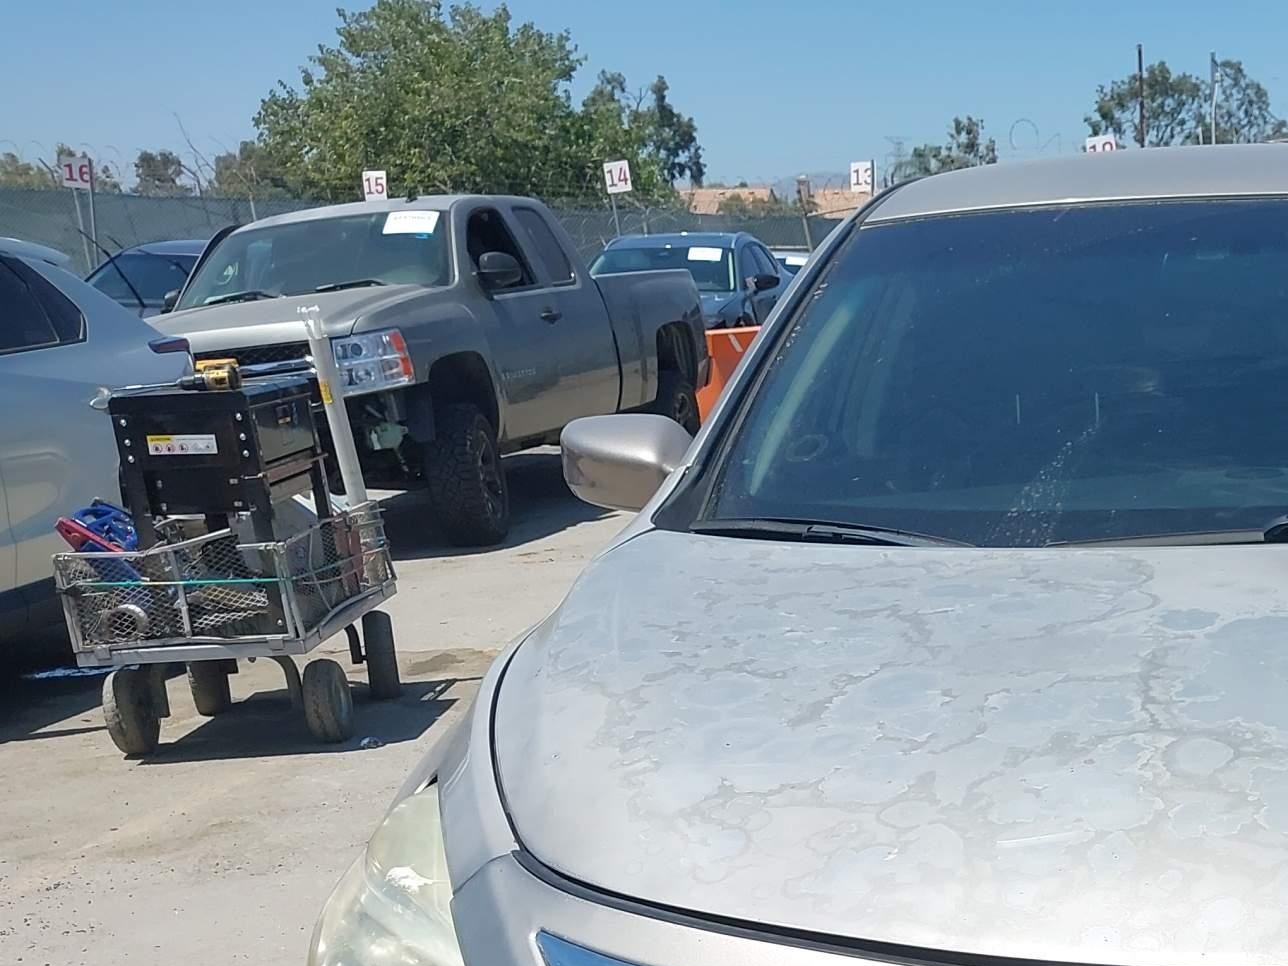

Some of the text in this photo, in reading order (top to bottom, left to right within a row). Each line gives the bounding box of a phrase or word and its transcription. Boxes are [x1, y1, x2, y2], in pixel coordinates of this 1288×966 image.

[63, 163, 90, 183] 16
[607, 167, 628, 187] 14
[852, 167, 872, 186] 13
[365, 176, 384, 195] 15
